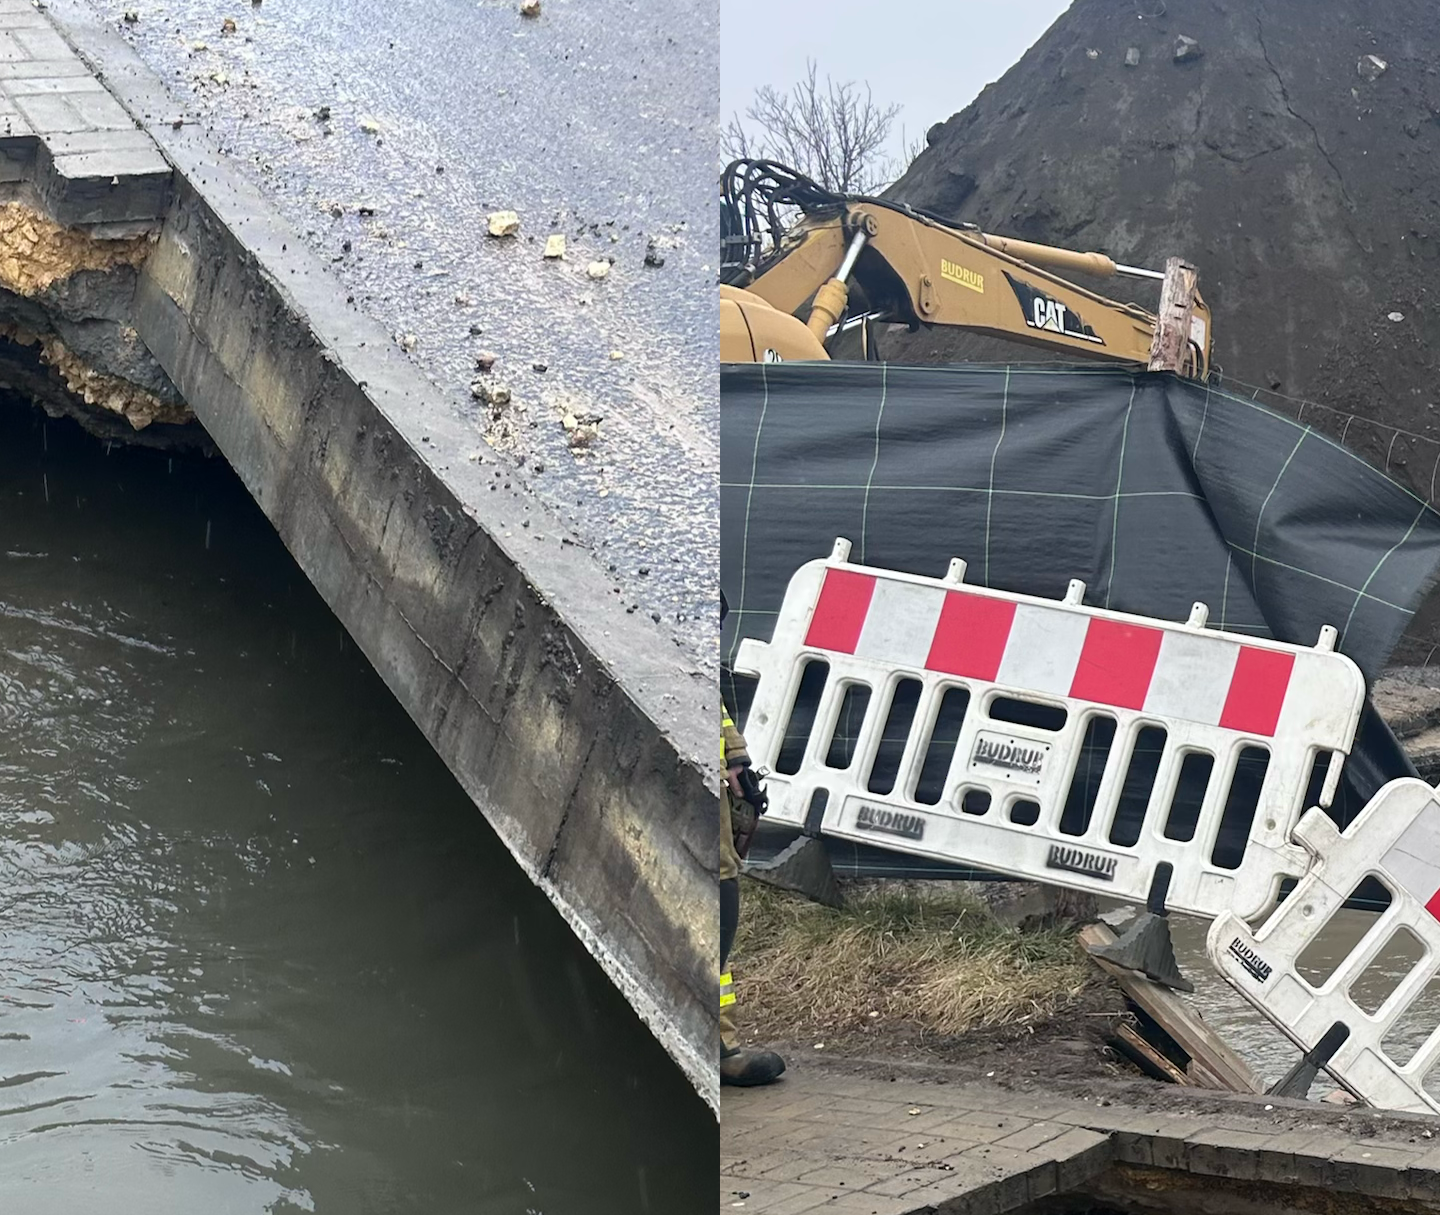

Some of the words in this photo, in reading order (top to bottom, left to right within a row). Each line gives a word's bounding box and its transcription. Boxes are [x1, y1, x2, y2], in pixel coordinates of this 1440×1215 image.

[941, 259, 984, 288] BUDRUR
[1033, 297, 1067, 333] CAT
[858, 806, 926, 834] BUDRUR
[1048, 844, 1118, 874] BUDRUR
[1231, 937, 1273, 978] BUDRUR
